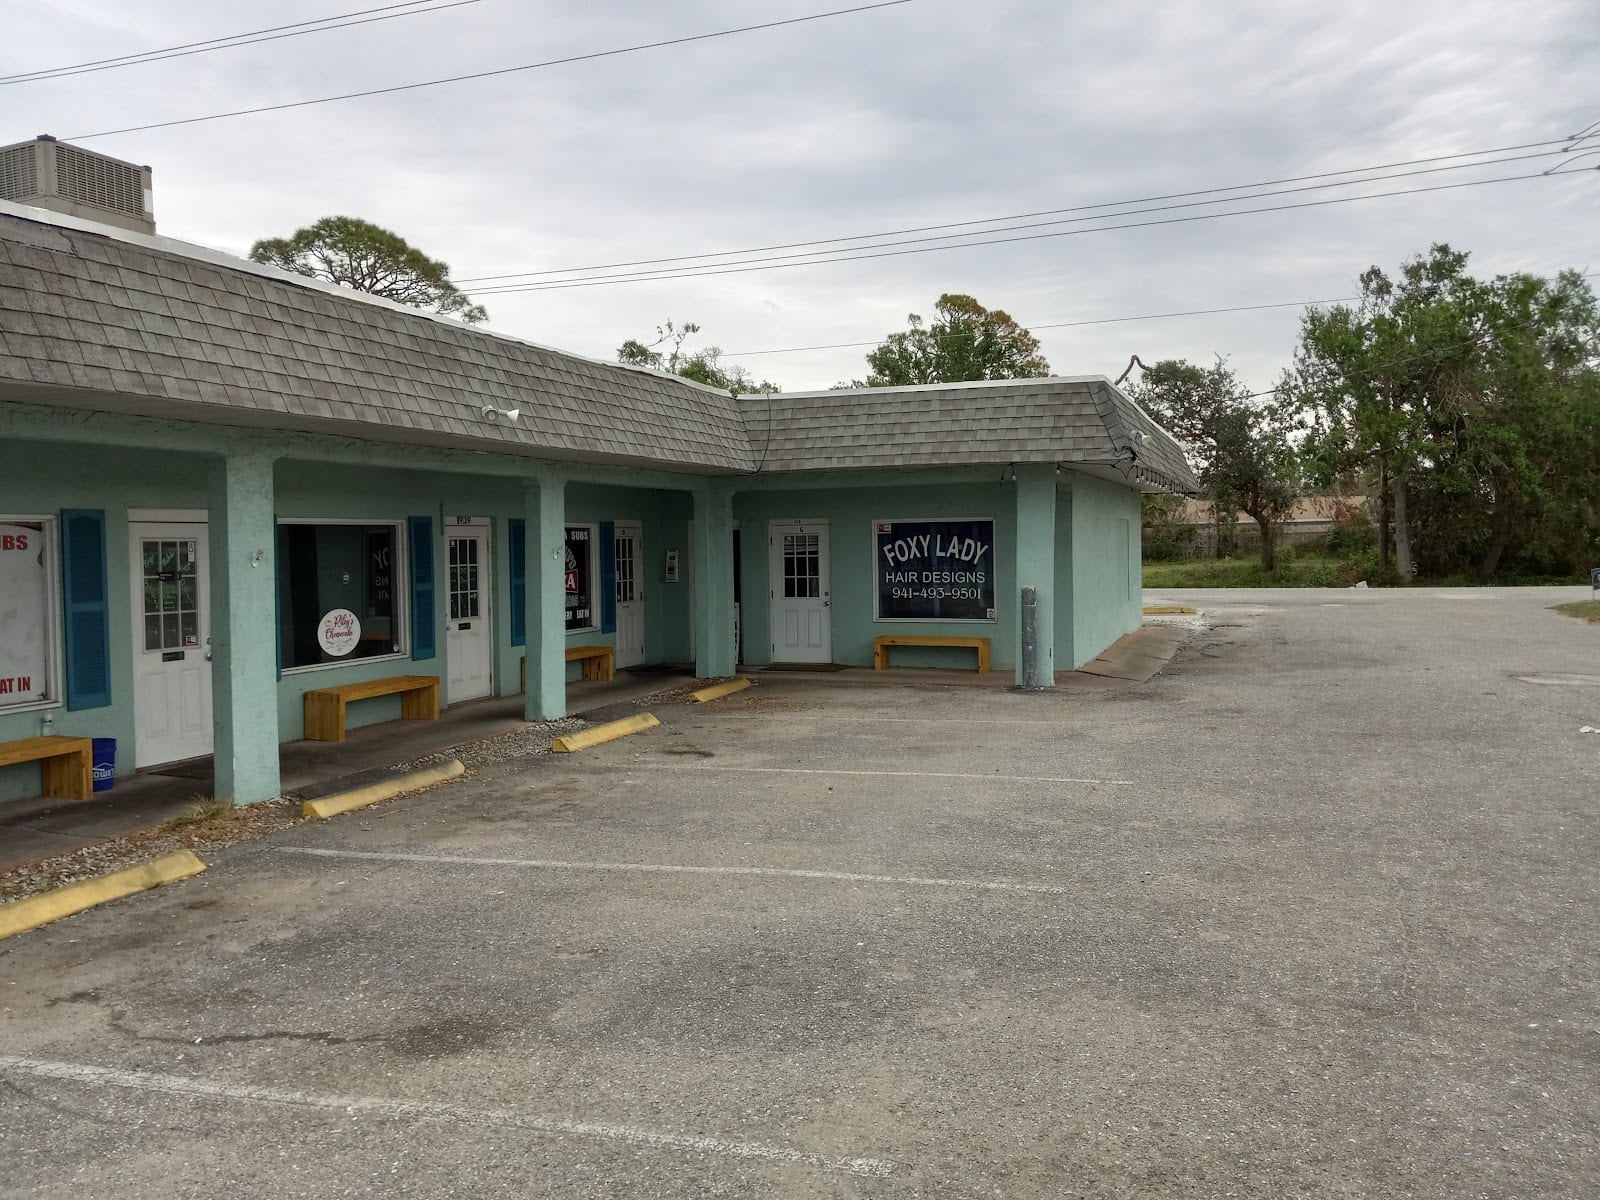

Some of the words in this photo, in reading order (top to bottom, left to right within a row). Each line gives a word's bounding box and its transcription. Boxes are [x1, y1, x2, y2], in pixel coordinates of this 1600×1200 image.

[0, 534, 29, 550] BS
[570, 530, 589, 541] SUBS
[882, 534, 931, 567] FOXY
[935, 534, 989, 565] LADY
[885, 571, 919, 584] HAIR
[922, 571, 986, 584] DESIGNS
[892, 587, 982, 600] 941-493-9501
[17, 676, 31, 692] IN
